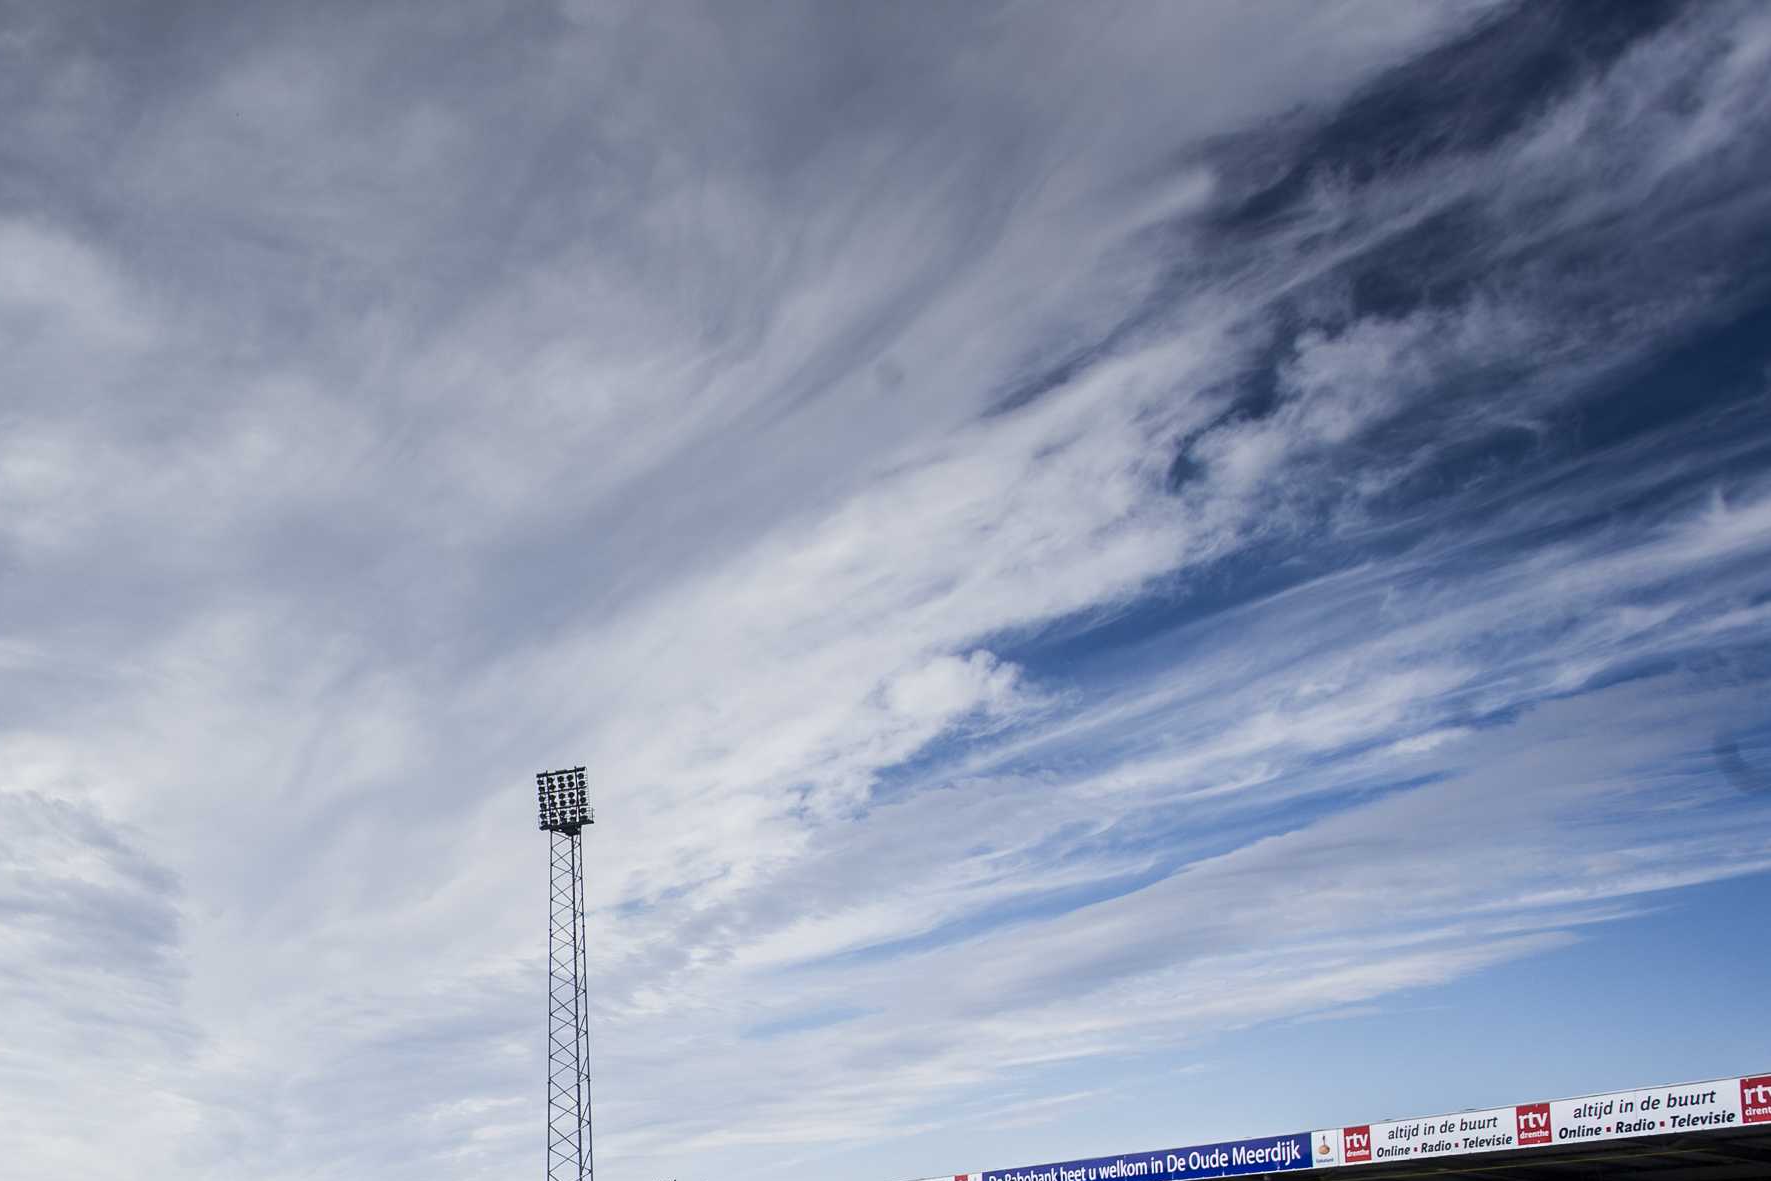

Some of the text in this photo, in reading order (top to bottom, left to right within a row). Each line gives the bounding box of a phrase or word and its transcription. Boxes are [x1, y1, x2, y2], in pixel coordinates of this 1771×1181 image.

[1574, 1090, 1716, 1119] altijd in de buurt
[1745, 1104, 1771, 1117] drent
[1388, 1116, 1498, 1140] altijd in de buurt
[1519, 1110, 1548, 1129] rtv
[1559, 1111, 1735, 1139] Online Radio Televisie
[1345, 1131, 1369, 1149] rtv
[1377, 1133, 1513, 1158] Online Radio Televisie
[1520, 1129, 1549, 1139] drenthe
[1088, 1169, 1097, 1180] u
[1099, 1160, 1148, 1180] welkom
[1151, 1158, 1163, 1174] in
[1167, 1155, 1186, 1173] De
[1189, 1149, 1228, 1169] Oude
[1232, 1141, 1300, 1167] Meerdijk
